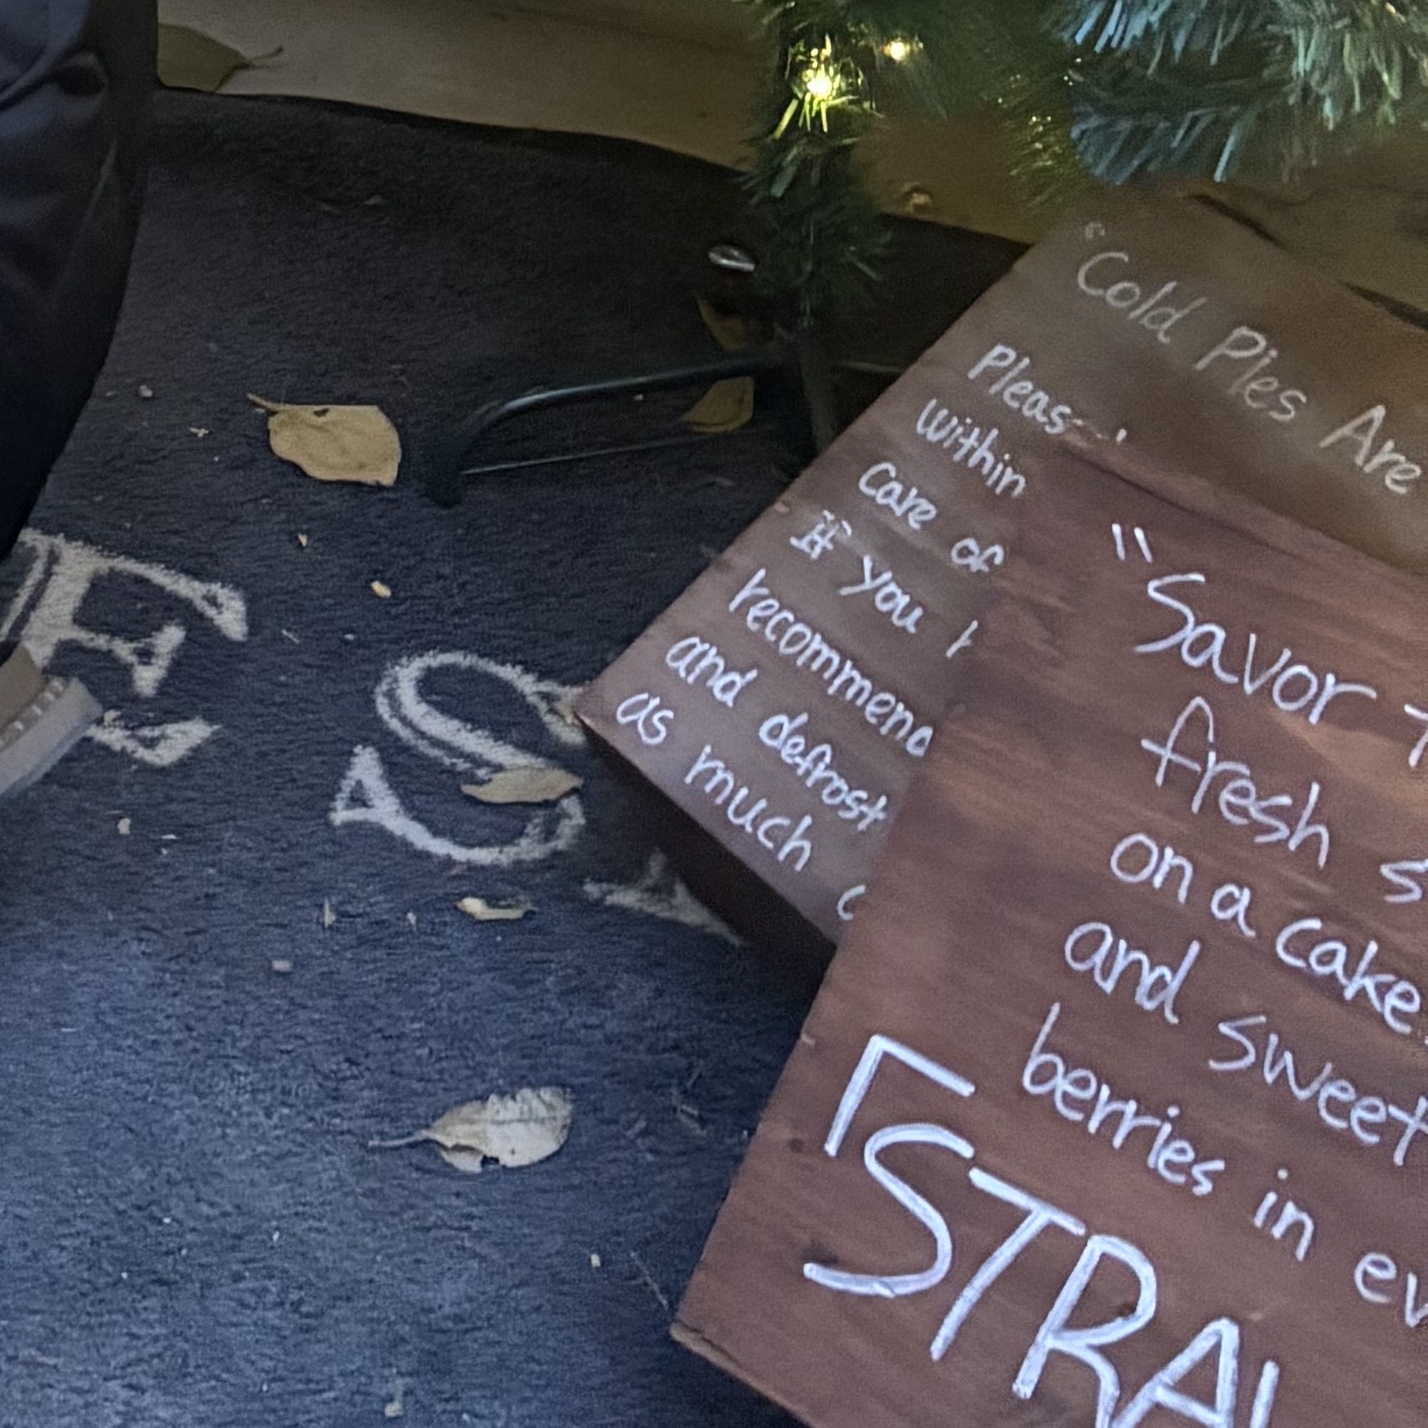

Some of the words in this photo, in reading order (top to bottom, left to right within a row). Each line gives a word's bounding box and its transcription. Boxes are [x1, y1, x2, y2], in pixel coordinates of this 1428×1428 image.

[1195, 326, 1307, 422] Pies
[1318, 404, 1422, 494] Are
[840, 556, 926, 634] you
[950, 538, 1003, 575] of
[616, 692, 675, 746] as
[684, 742, 812, 874] much
[666, 635, 756, 708] and
[759, 711, 887, 832] defrost
[1141, 698, 1332, 868] fresh
[1111, 833, 1194, 904] on
[1210, 883, 1256, 938] a
[1066, 922, 1201, 1024] and
[1208, 1014, 1428, 1166] sweet
[1023, 1003, 1225, 1196] berries
[1255, 1168, 1315, 1261] in
